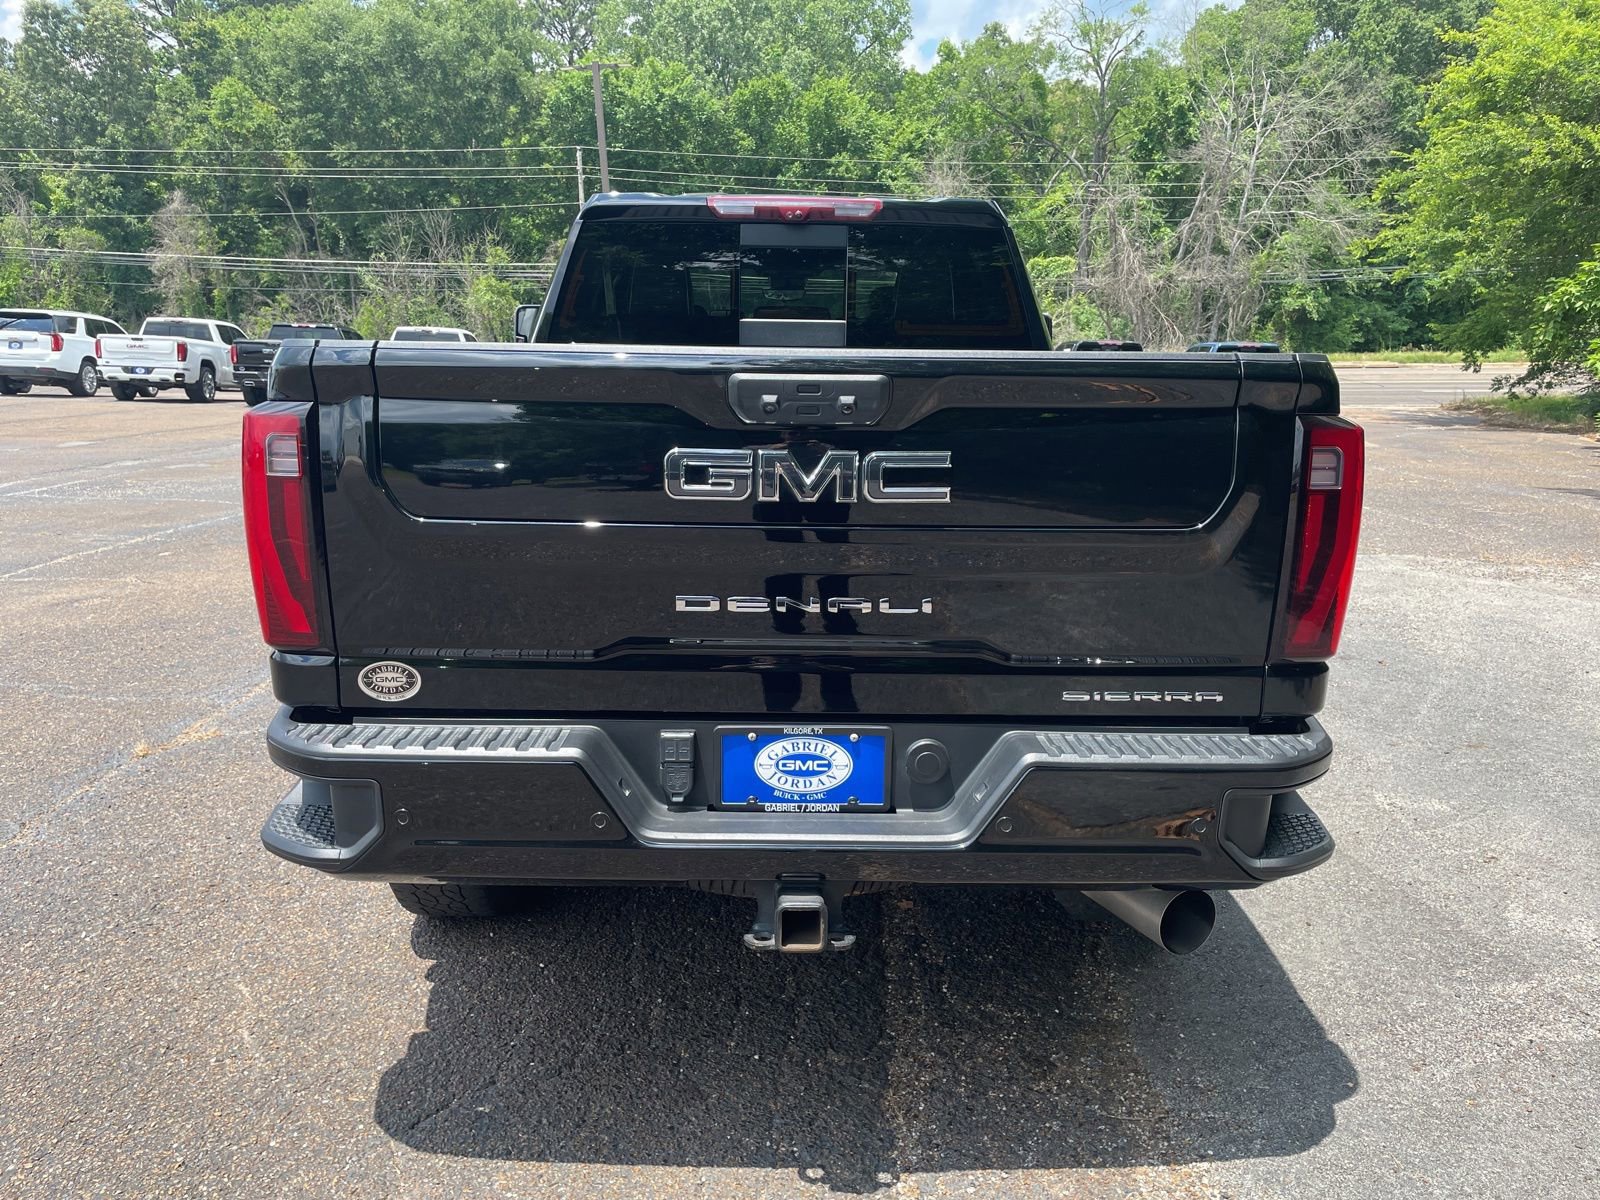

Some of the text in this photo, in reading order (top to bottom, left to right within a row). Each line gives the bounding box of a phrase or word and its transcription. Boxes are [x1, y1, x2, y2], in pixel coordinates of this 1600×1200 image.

[663, 447, 952, 503] GMC
[675, 595, 933, 614] DENALI
[367, 665, 410, 678] GABRIEL
[369, 683, 410, 694] JORDAN
[1062, 691, 1224, 702] SIERRA
[813, 727, 823, 735] TX
[767, 741, 838, 762] GABRIEL
[778, 760, 829, 771] GMC
[767, 771, 839, 789] JORDAN
[773, 789, 801, 801] BUICK
[806, 791, 828, 801] GMC
[764, 803, 800, 812] GABRIEL
[805, 803, 840, 812] JORDAN
